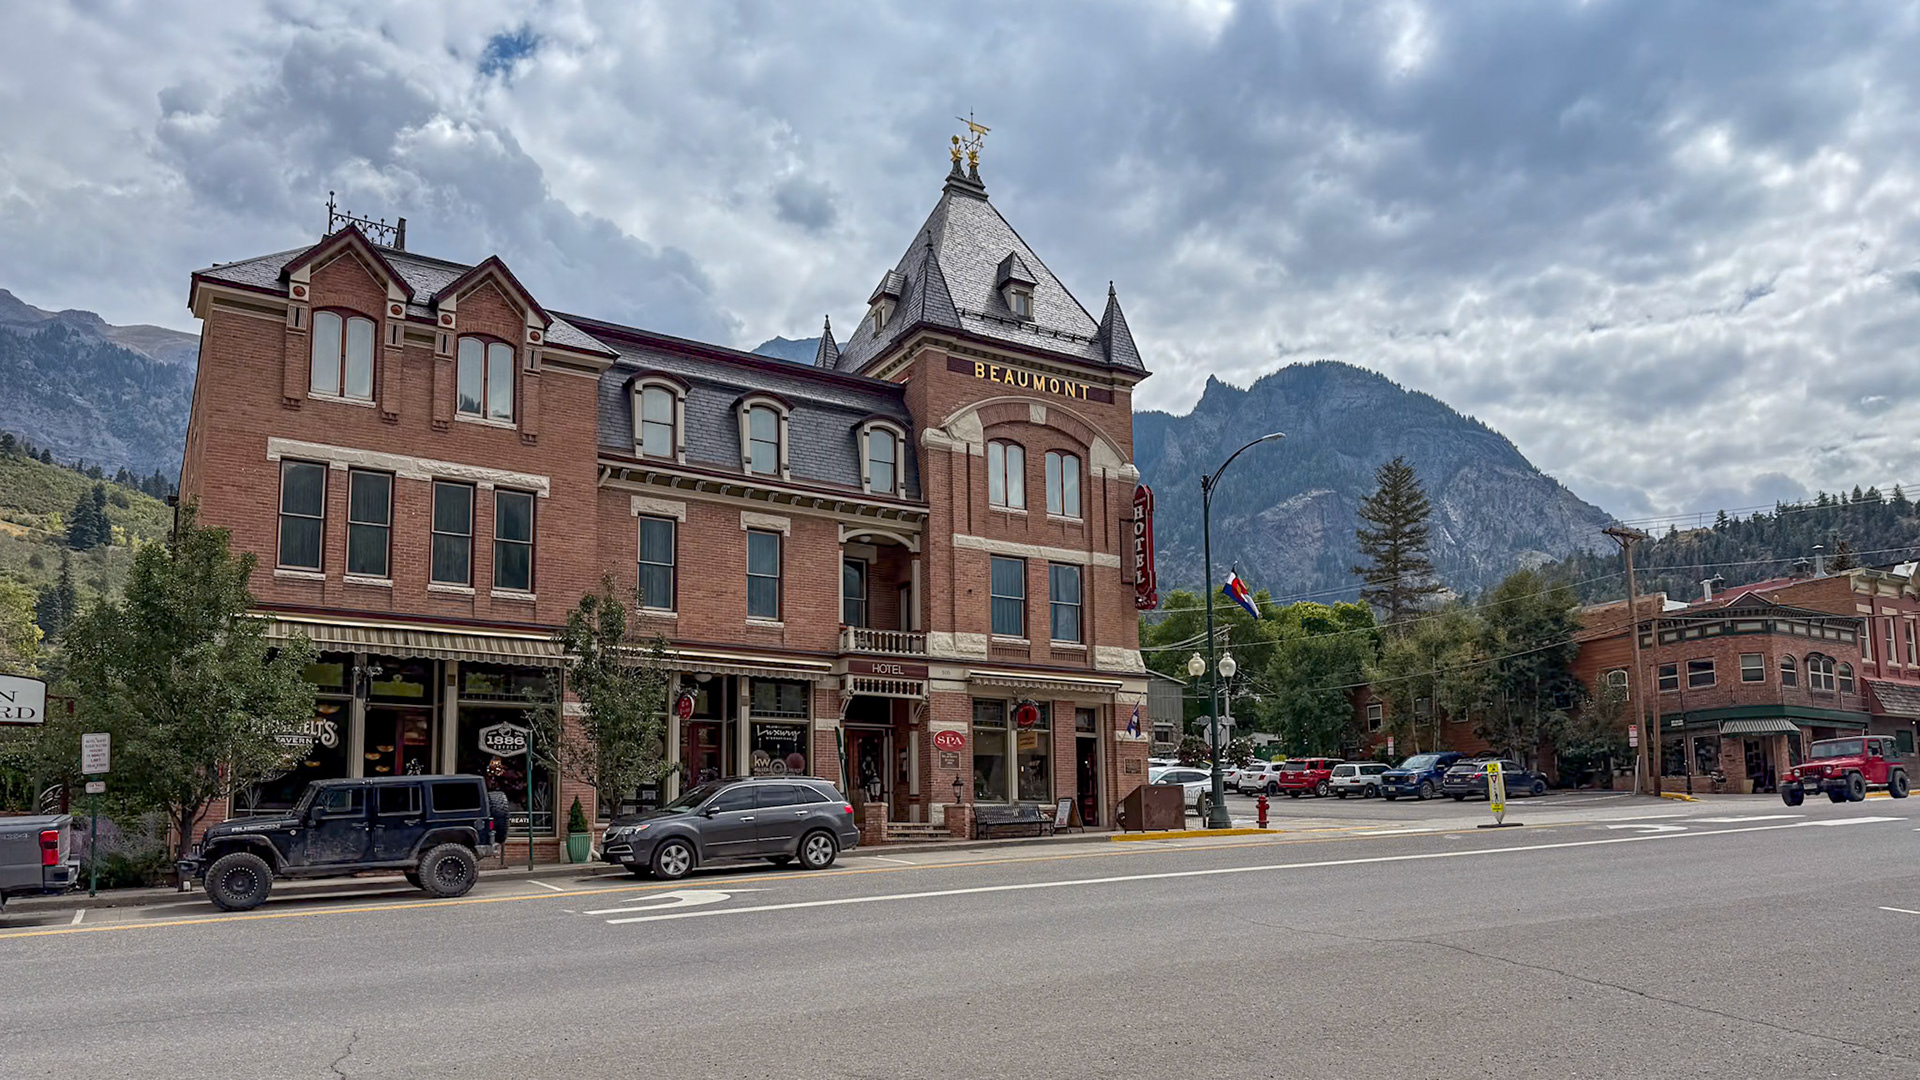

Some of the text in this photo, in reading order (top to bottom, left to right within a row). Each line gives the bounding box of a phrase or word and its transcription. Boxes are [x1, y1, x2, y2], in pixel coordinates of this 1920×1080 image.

[974, 361, 1090, 401] BEAUMONT
[1133, 505, 1146, 585] HOTEL
[872, 663, 905, 675] HOTEL
[756, 724, 801, 741] Luxury
[486, 735, 525, 745] 1886
[936, 735, 963, 745] SPA
[754, 754, 771, 767] kw
